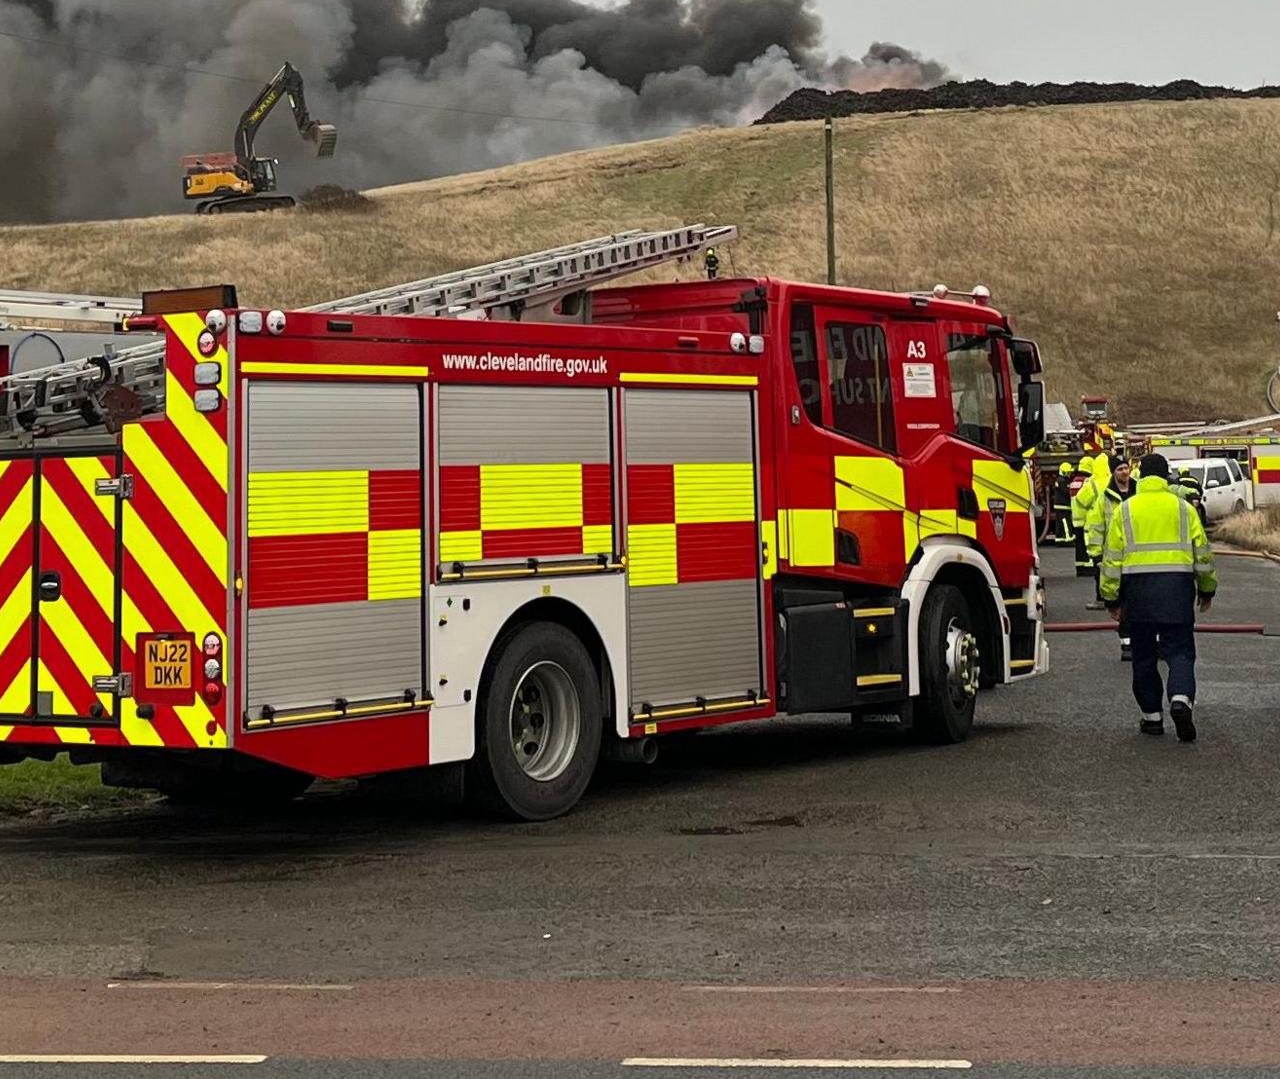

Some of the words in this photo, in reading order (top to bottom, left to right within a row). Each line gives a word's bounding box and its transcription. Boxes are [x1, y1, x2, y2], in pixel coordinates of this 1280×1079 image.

[907, 340, 926, 358] A3
[442, 352, 608, 377] www.clevelandfire.gov.uk
[149, 644, 187, 662] NJ22
[154, 666, 182, 685] DKK
